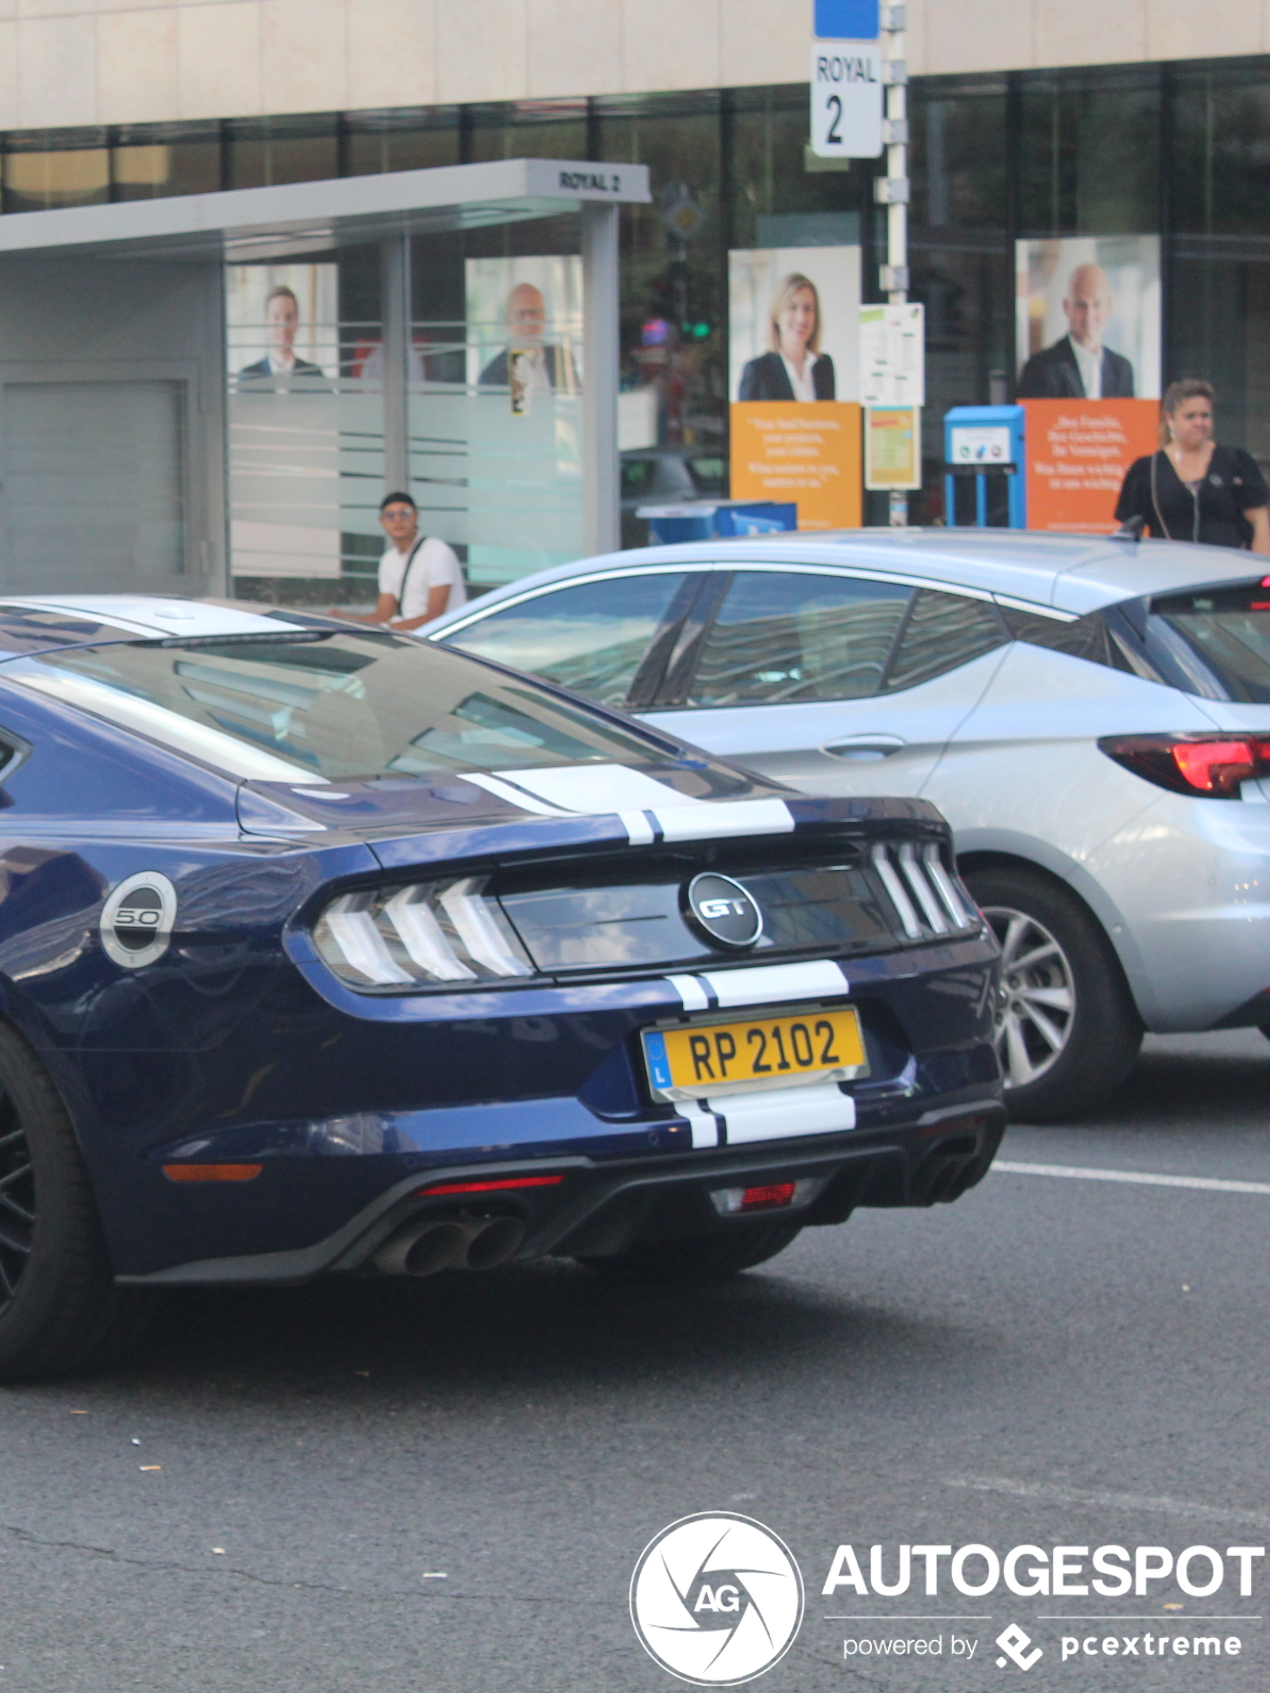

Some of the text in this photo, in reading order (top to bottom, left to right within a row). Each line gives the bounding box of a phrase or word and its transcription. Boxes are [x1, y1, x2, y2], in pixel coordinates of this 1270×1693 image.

[817, 56, 877, 82] ROYAL
[826, 95, 842, 144] 2
[559, 171, 620, 192] ROYAL 2
[699, 898, 747, 919] GT
[688, 1031, 737, 1080] RP
[746, 1020, 840, 1074] 2102
